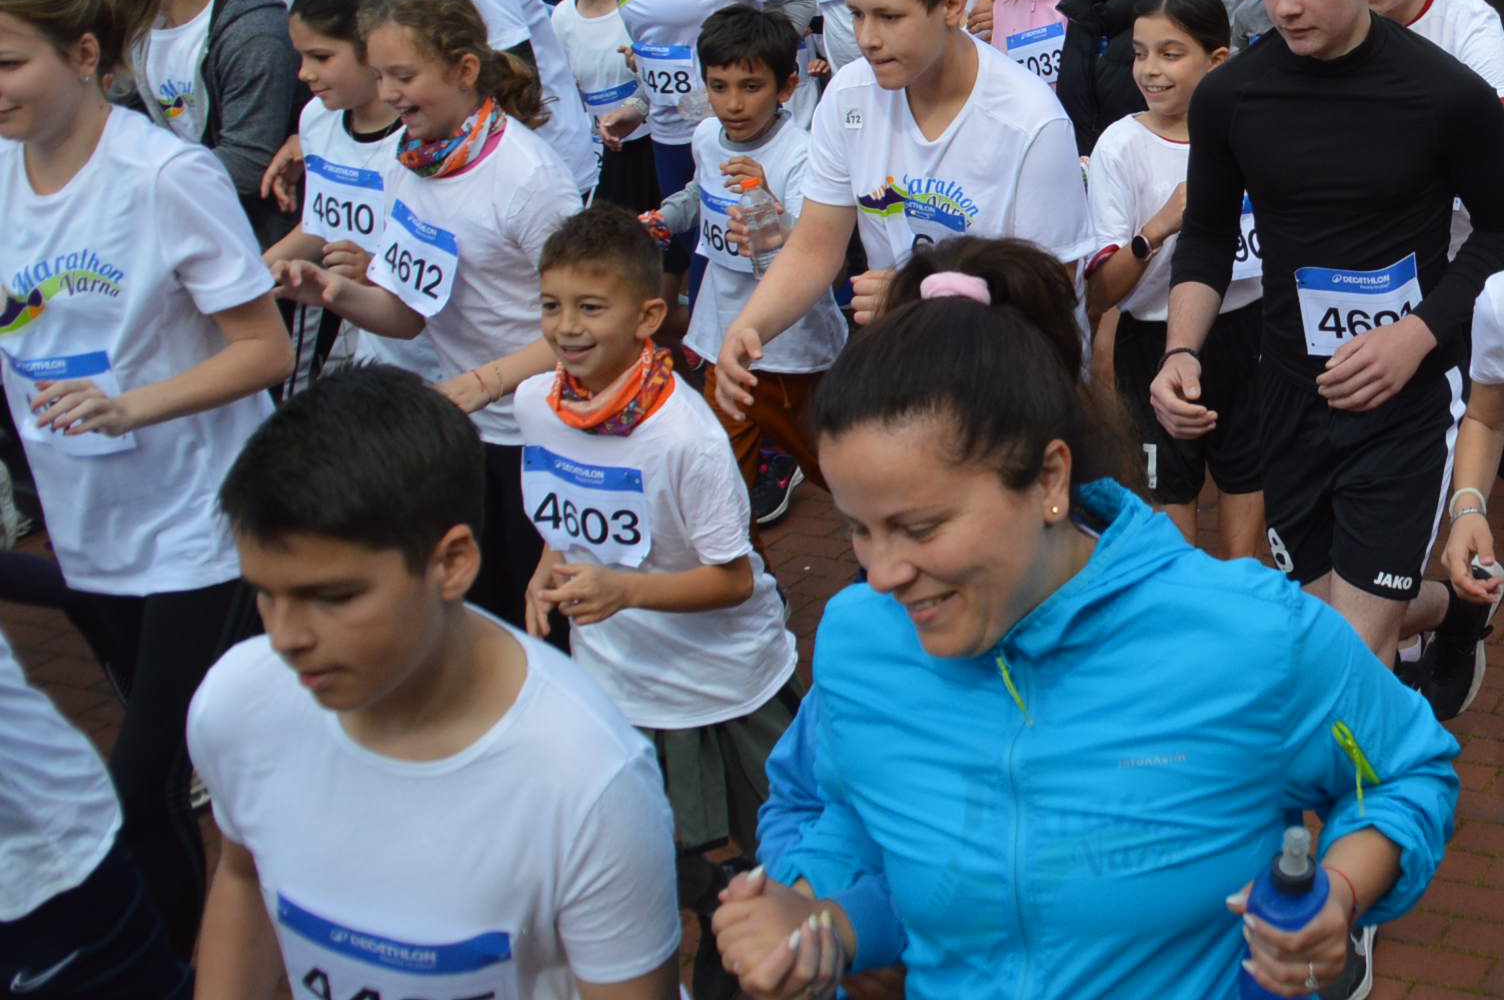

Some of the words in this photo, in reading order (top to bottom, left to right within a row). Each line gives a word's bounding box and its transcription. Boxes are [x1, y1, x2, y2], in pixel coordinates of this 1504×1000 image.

[1017, 50, 1062, 76] 033
[313, 192, 374, 235] 4610
[903, 174, 979, 217] arathon
[12, 248, 125, 294] Marathon
[60, 270, 120, 298] Varna
[384, 242, 443, 300] 4612
[1343, 273, 1390, 285] DECATHLON
[534, 492, 641, 546] 4603
[1373, 571, 1413, 590] JAKO
[351, 933, 437, 962] DECATHLON
